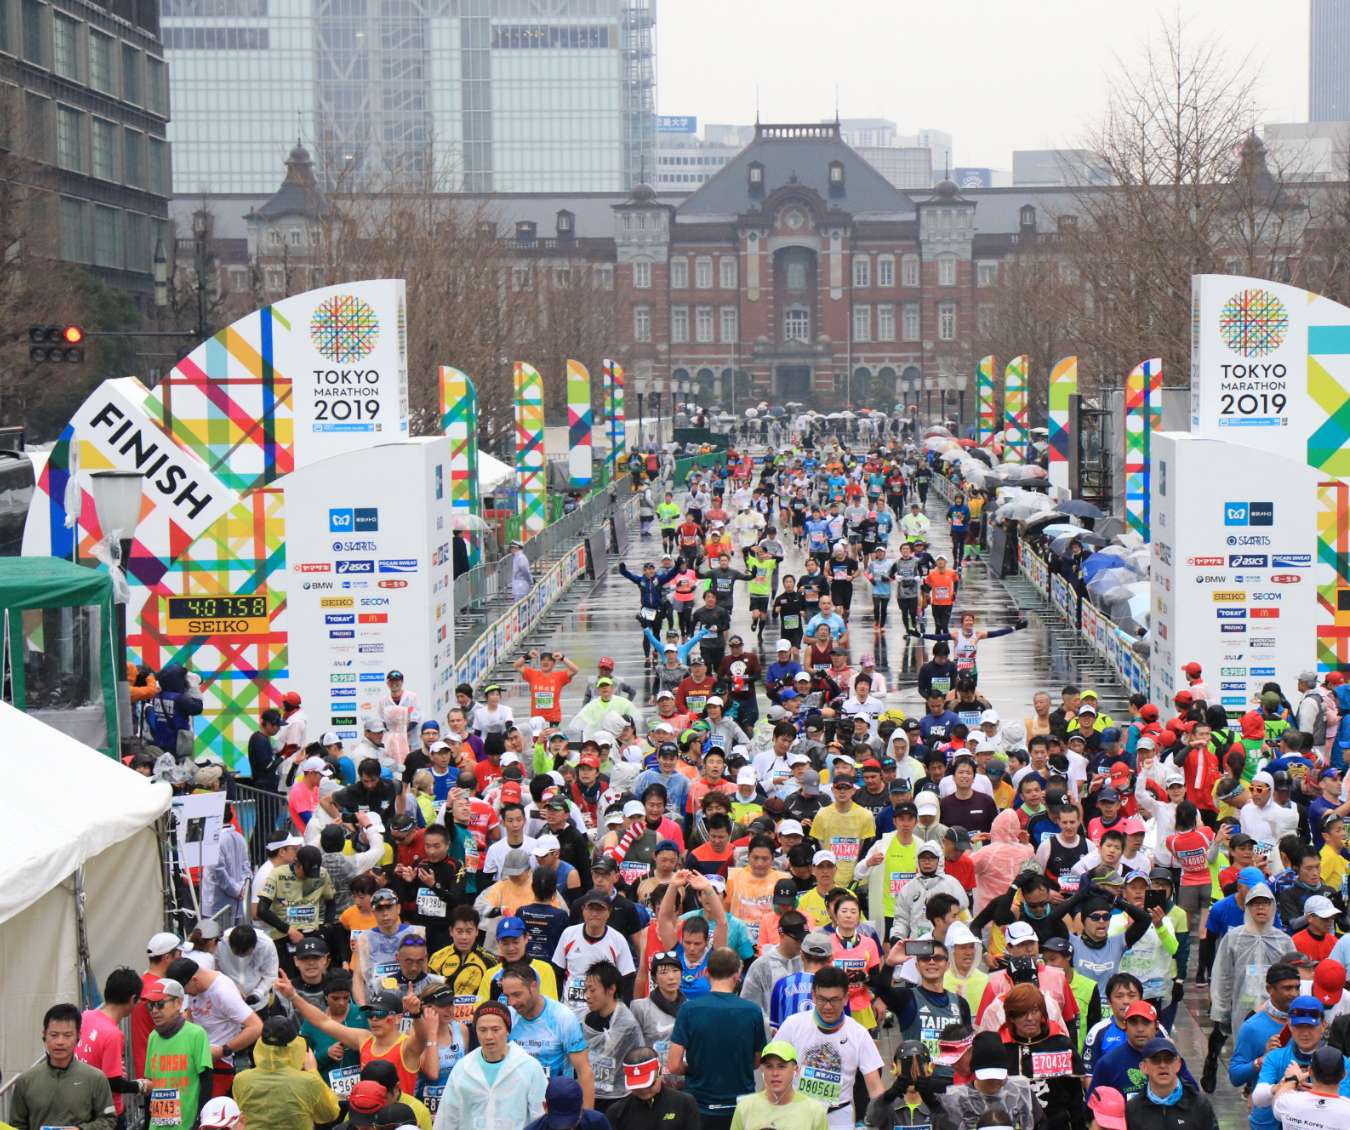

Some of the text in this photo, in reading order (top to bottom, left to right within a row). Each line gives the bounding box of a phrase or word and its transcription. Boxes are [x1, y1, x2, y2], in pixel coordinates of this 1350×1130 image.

[1220, 364, 1287, 378] TOKYO
[313, 370, 379, 384] TOKYO
[1221, 381, 1286, 391] MARATHON
[314, 387, 379, 397] MARATHON
[1221, 393, 1287, 415] 2019
[314, 400, 380, 420] 2019
[90, 402, 213, 520] FINISH
[344, 541, 376, 551] STARTS
[1238, 536, 1271, 545] STARTS
[1205, 575, 1226, 583] BMW
[1253, 592, 1282, 600] SECOM
[360, 598, 389, 606] SECOM
[188, 620, 249, 633] SEIKO
[799, 1077, 835, 1098] D80561
